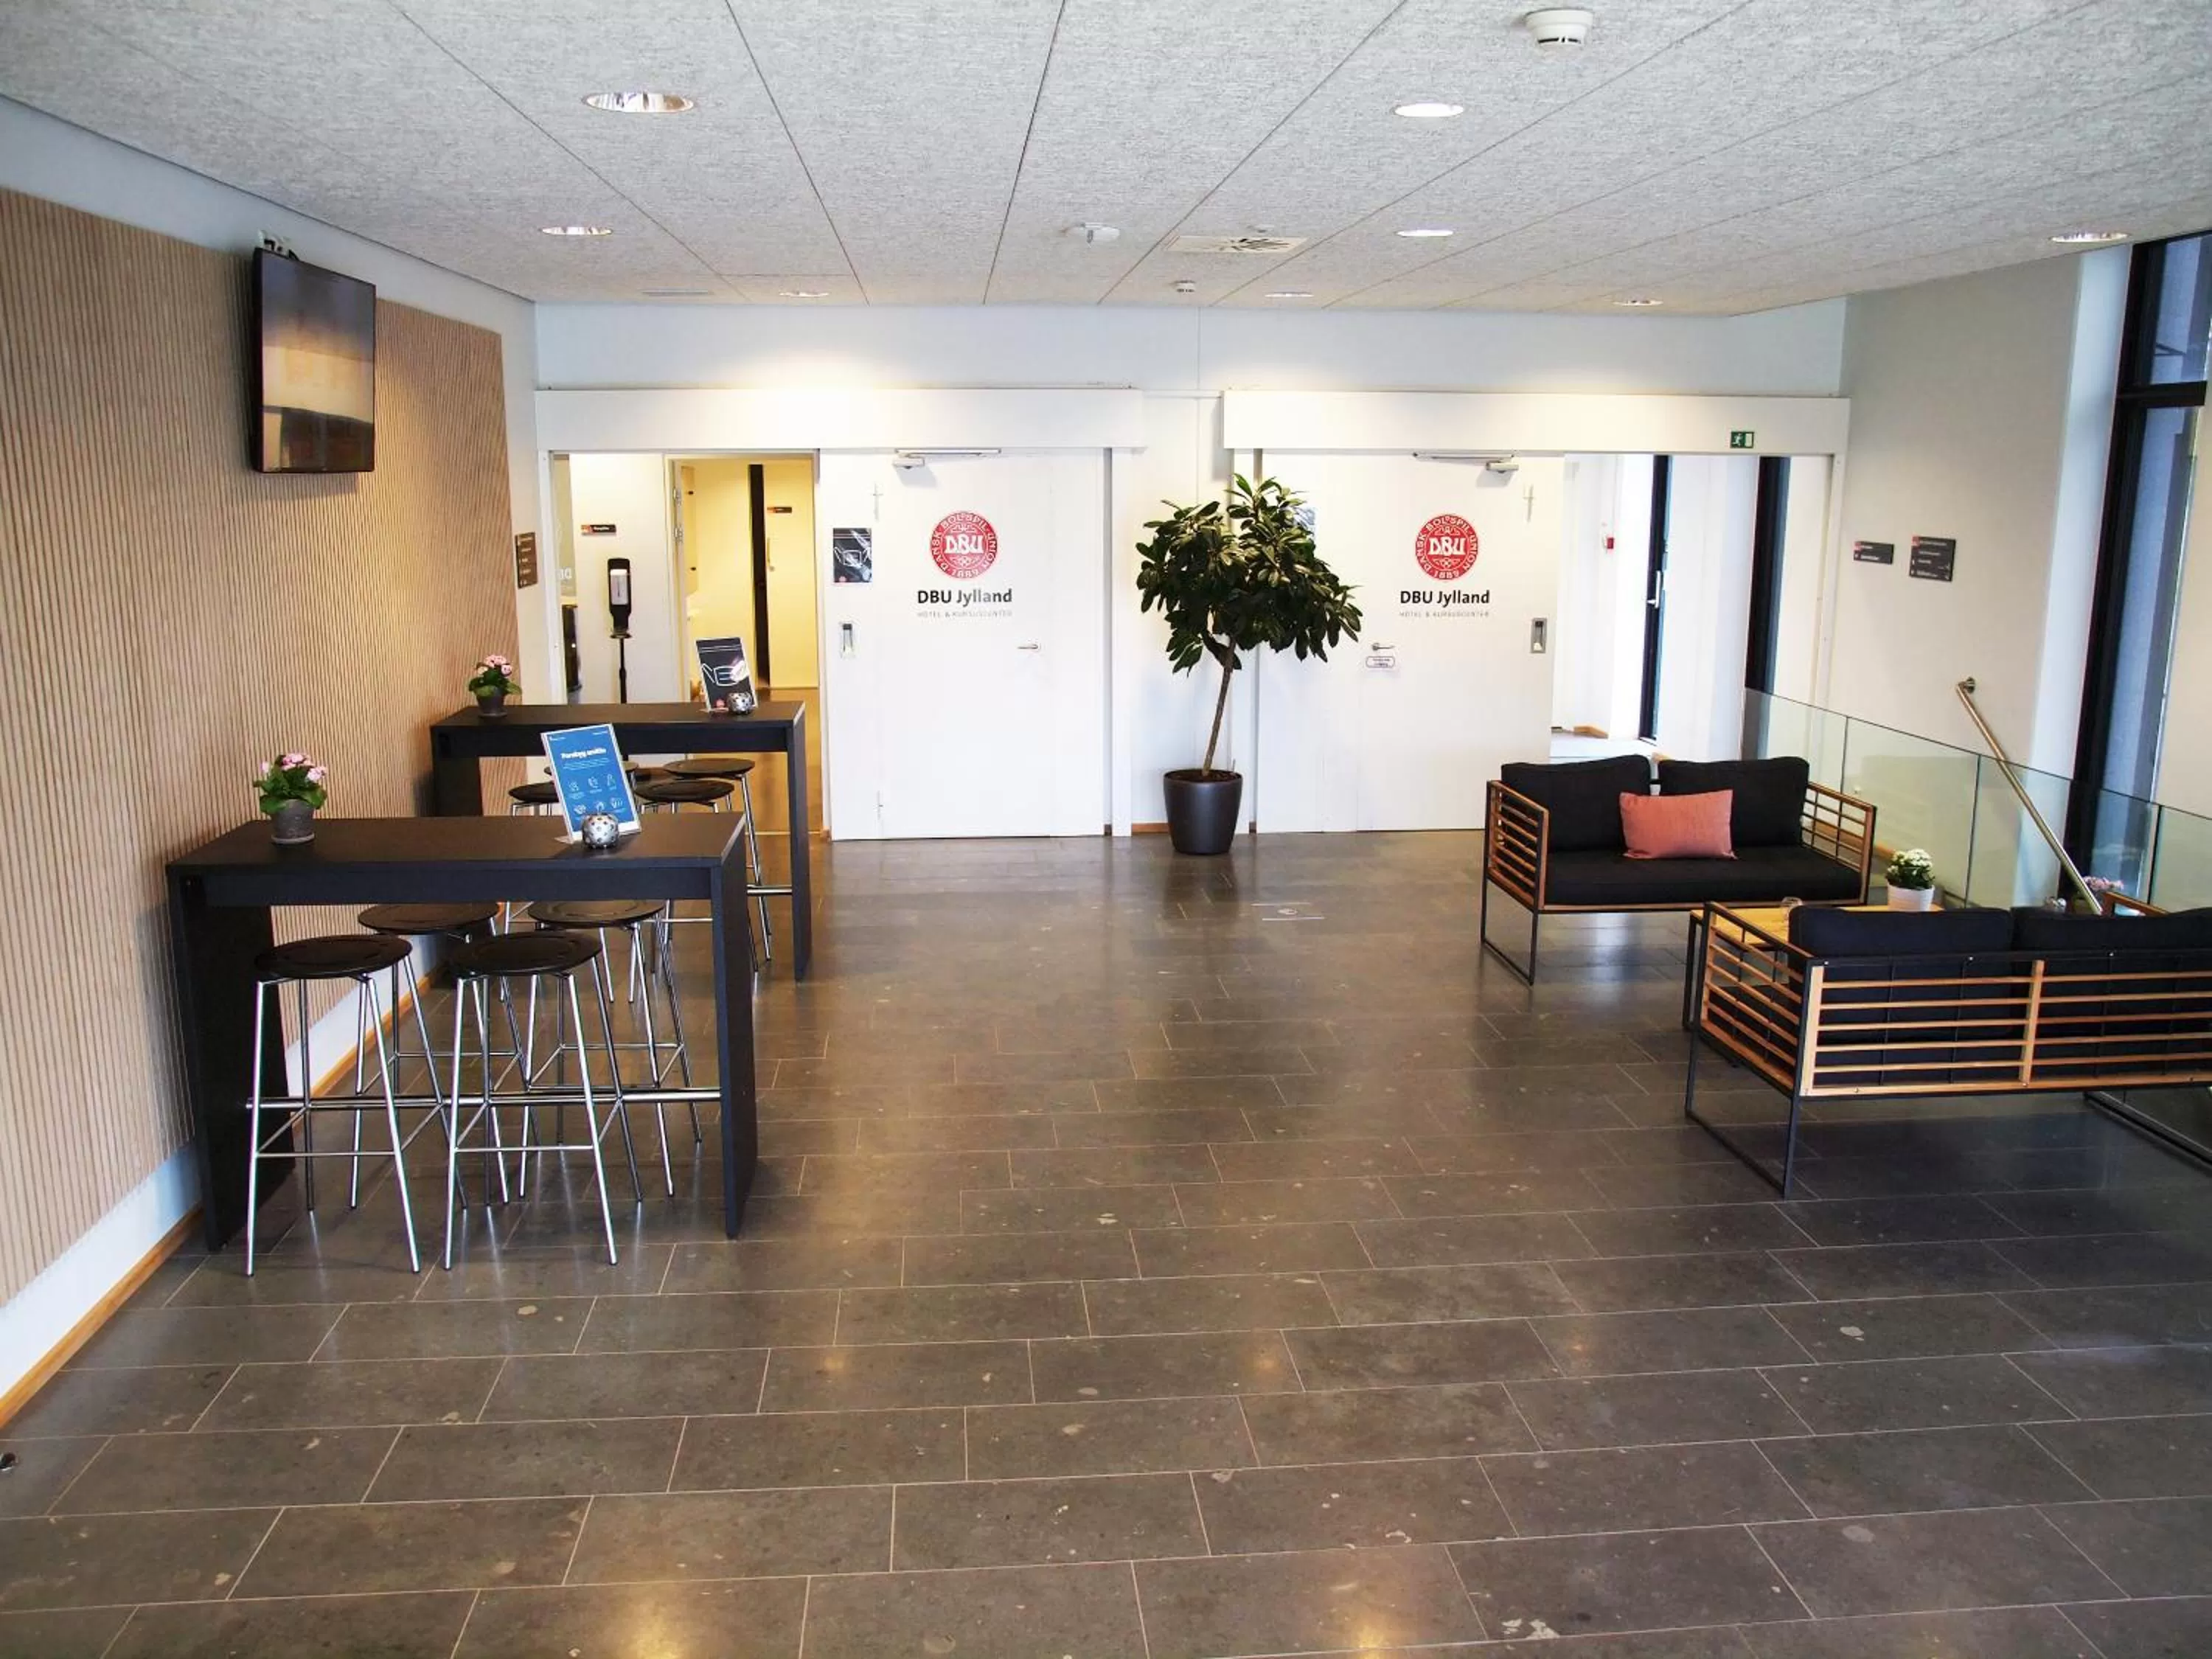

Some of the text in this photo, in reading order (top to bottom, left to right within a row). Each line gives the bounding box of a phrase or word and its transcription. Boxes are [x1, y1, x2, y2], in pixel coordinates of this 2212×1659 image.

[945, 533, 984, 554] DBU
[1427, 536, 1467, 557] DBU
[917, 588, 1012, 608] DBU Jylland
[1400, 589, 1490, 608] DBU Jylland
